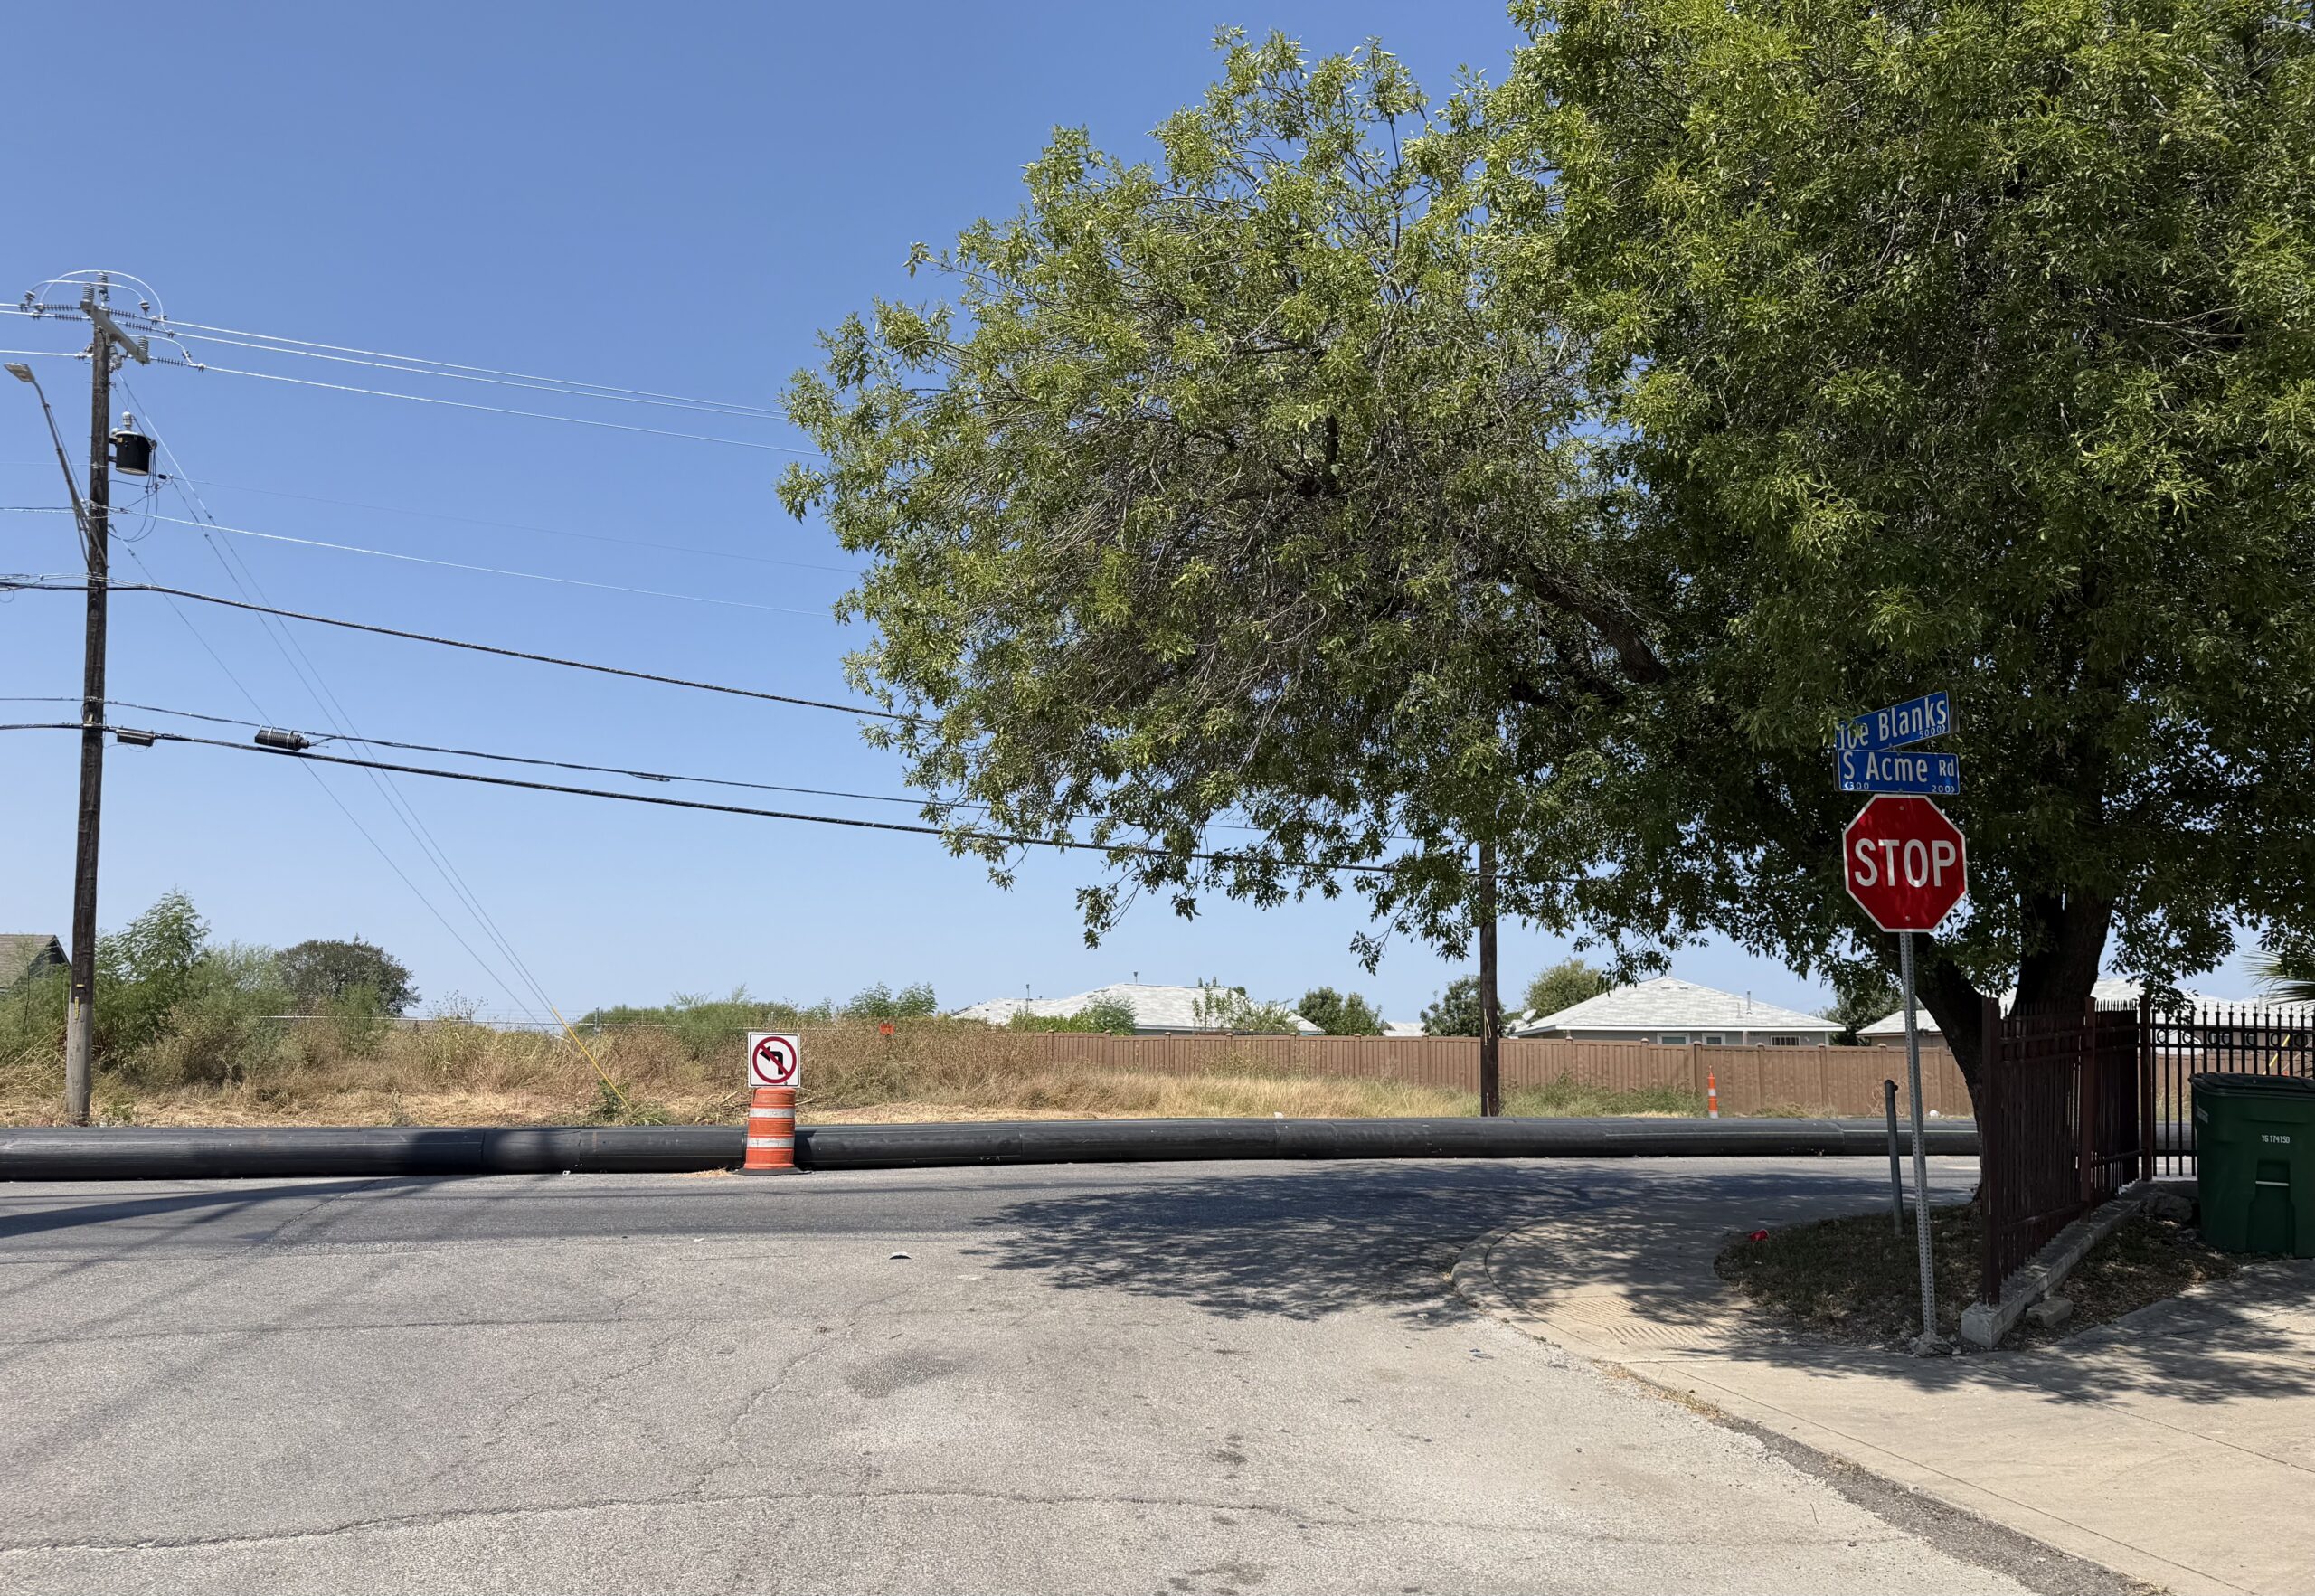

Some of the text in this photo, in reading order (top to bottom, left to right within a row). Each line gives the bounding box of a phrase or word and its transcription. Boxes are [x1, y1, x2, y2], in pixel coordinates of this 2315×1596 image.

[1878, 697, 1947, 741] Blanks
[1843, 751, 1955, 783] S Acme Rd
[1855, 838, 1956, 888] STOP
